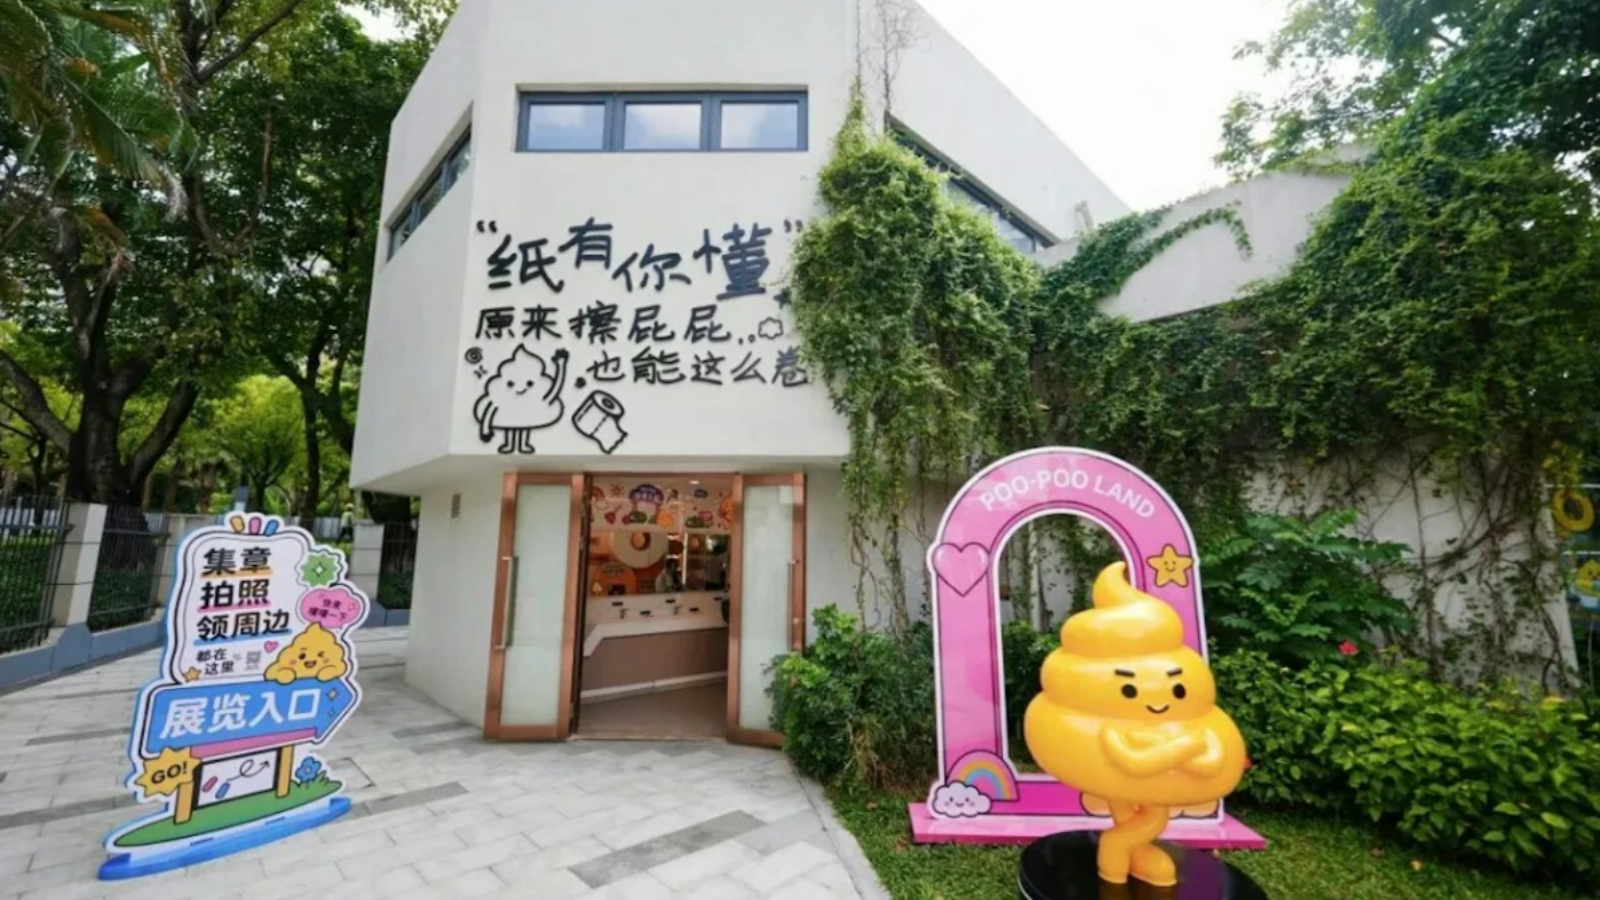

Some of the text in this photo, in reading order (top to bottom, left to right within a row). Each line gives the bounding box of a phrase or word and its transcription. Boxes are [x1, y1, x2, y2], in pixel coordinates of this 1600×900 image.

[586, 345, 809, 388] 也能这么卷
[978, 468, 1155, 518] POO-POO LAND
[202, 546, 272, 576] 集章
[200, 578, 270, 610] 拍照
[196, 608, 290, 642] 领周边
[204, 660, 235, 675] 这里
[159, 688, 321, 739] 展览入口
[151, 761, 188, 784] GO!
